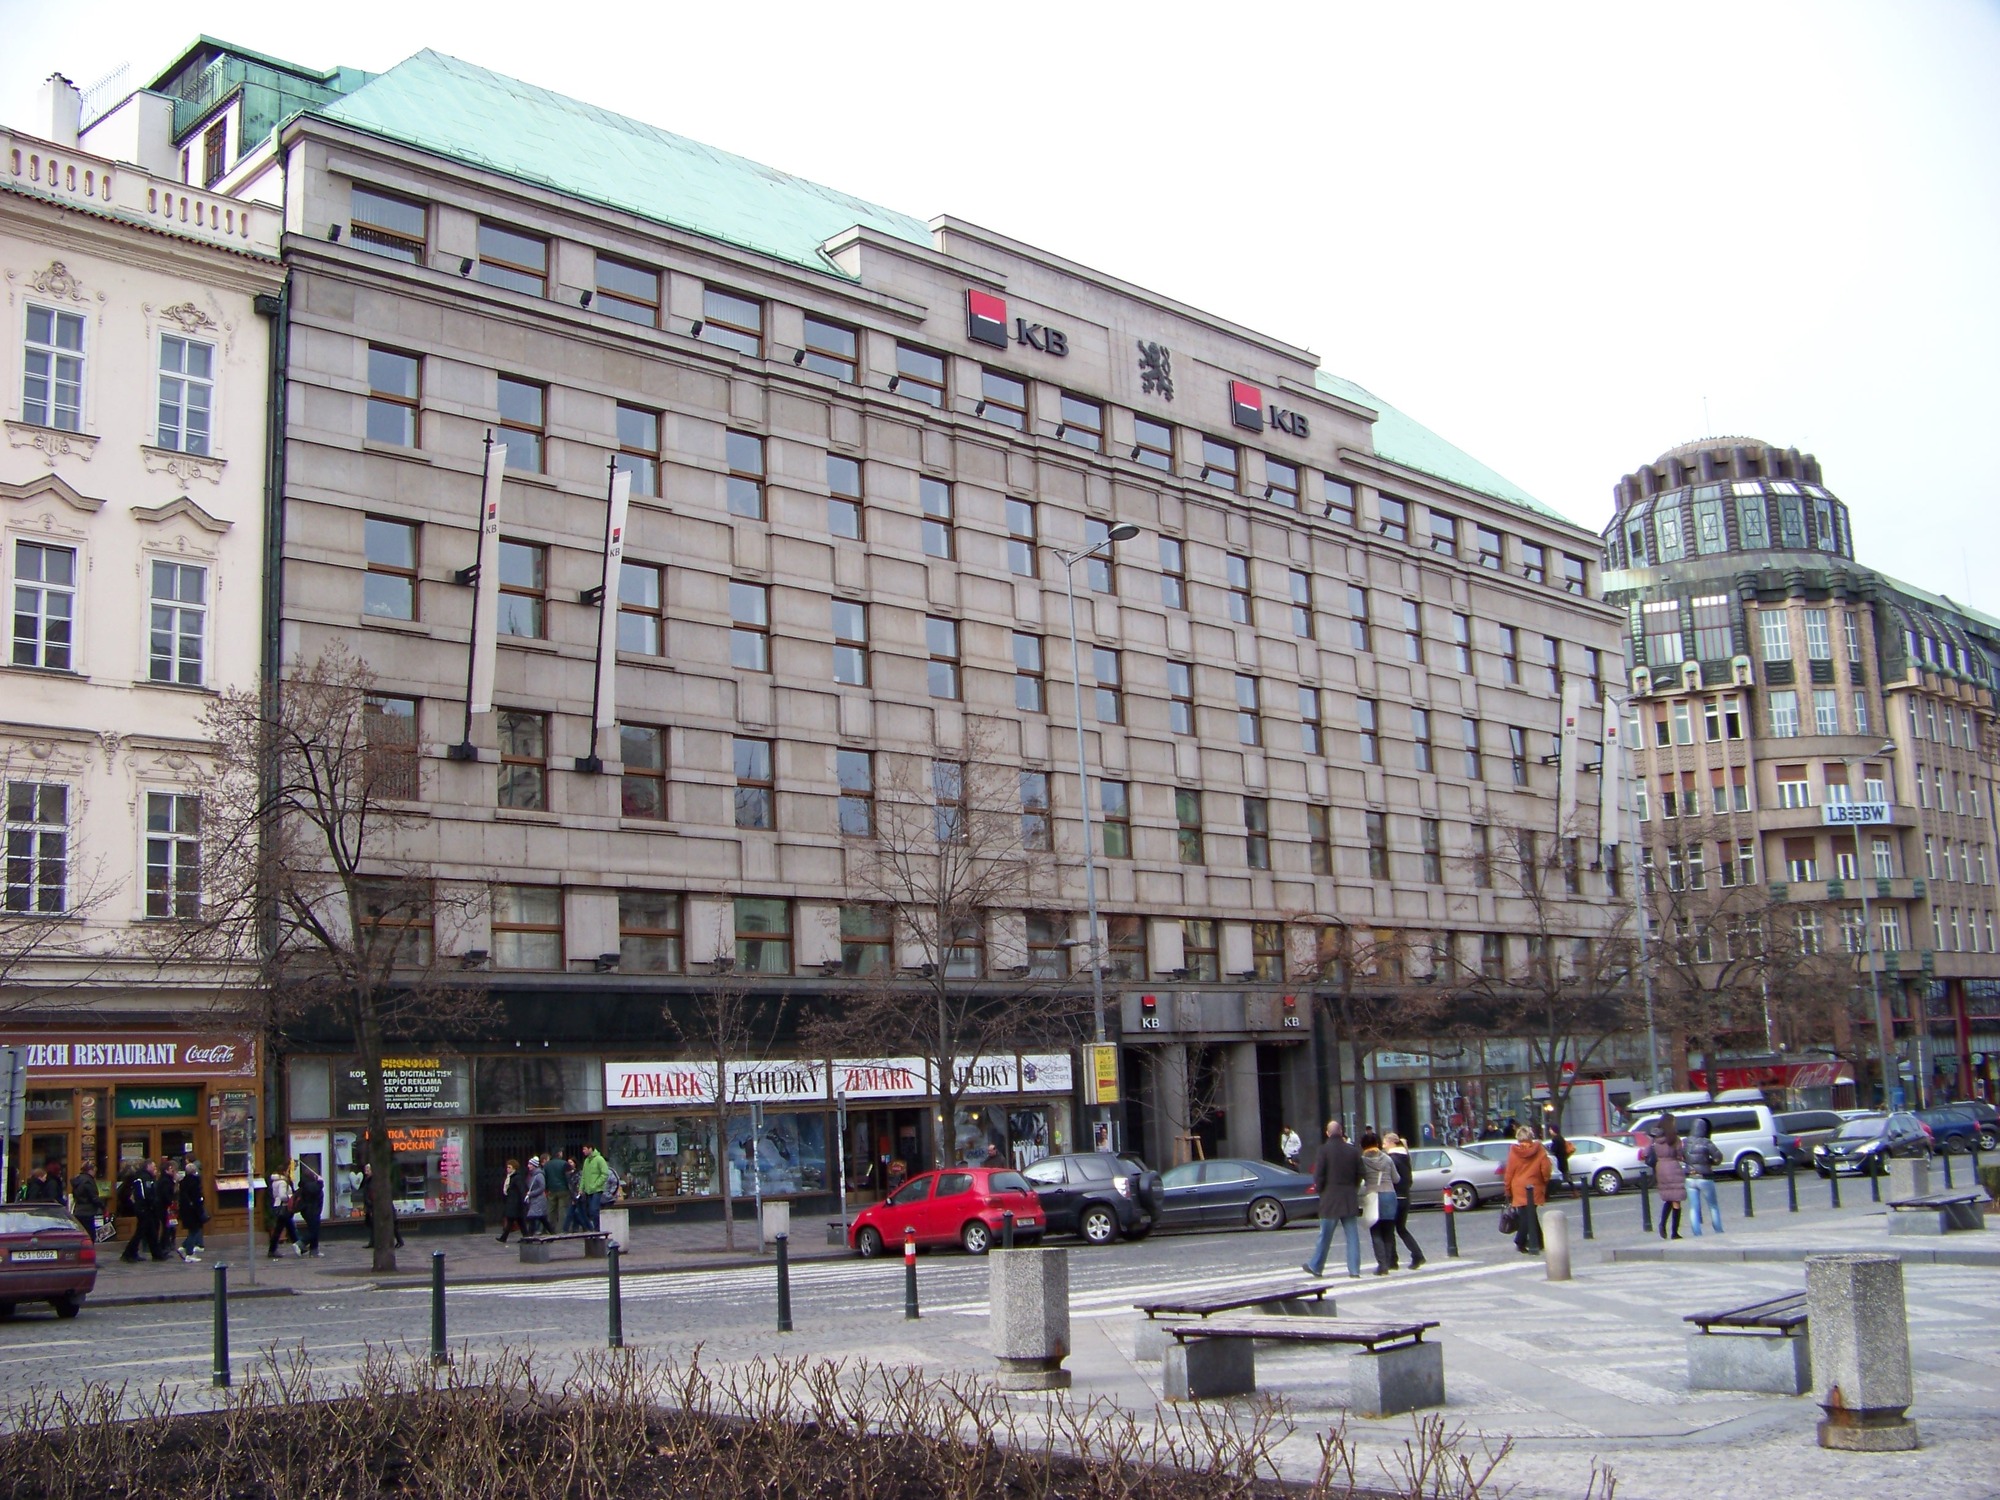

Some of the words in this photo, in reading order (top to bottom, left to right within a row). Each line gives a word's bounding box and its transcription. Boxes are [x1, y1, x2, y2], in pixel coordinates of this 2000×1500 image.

[1016, 317, 1070, 357] KB
[1269, 404, 1311, 439] KB
[485, 524, 497, 535] KB
[609, 547, 621, 557] KB
[1142, 1017, 1160, 1029] KB
[1284, 1016, 1300, 1027] KB
[26, 1044, 70, 1066] ZECH
[74, 1043, 177, 1066] RESTAURANT
[400, 1069, 436, 1078] DIGITÁLNÍ
[408, 1078, 442, 1086] REKLAMA
[620, 1072, 704, 1098] ZEMARK
[844, 1067, 914, 1092] ZEMARK
[130, 1096, 182, 1109] VINÁRNA
[386, 1102, 403, 1110] FAX,
[403, 1102, 432, 1110] BACKUP
[433, 1101, 460, 1109] CD,DVD
[410, 1129, 445, 1138] VIZITKY
[393, 1140, 436, 1151] POČKÁNÍ
